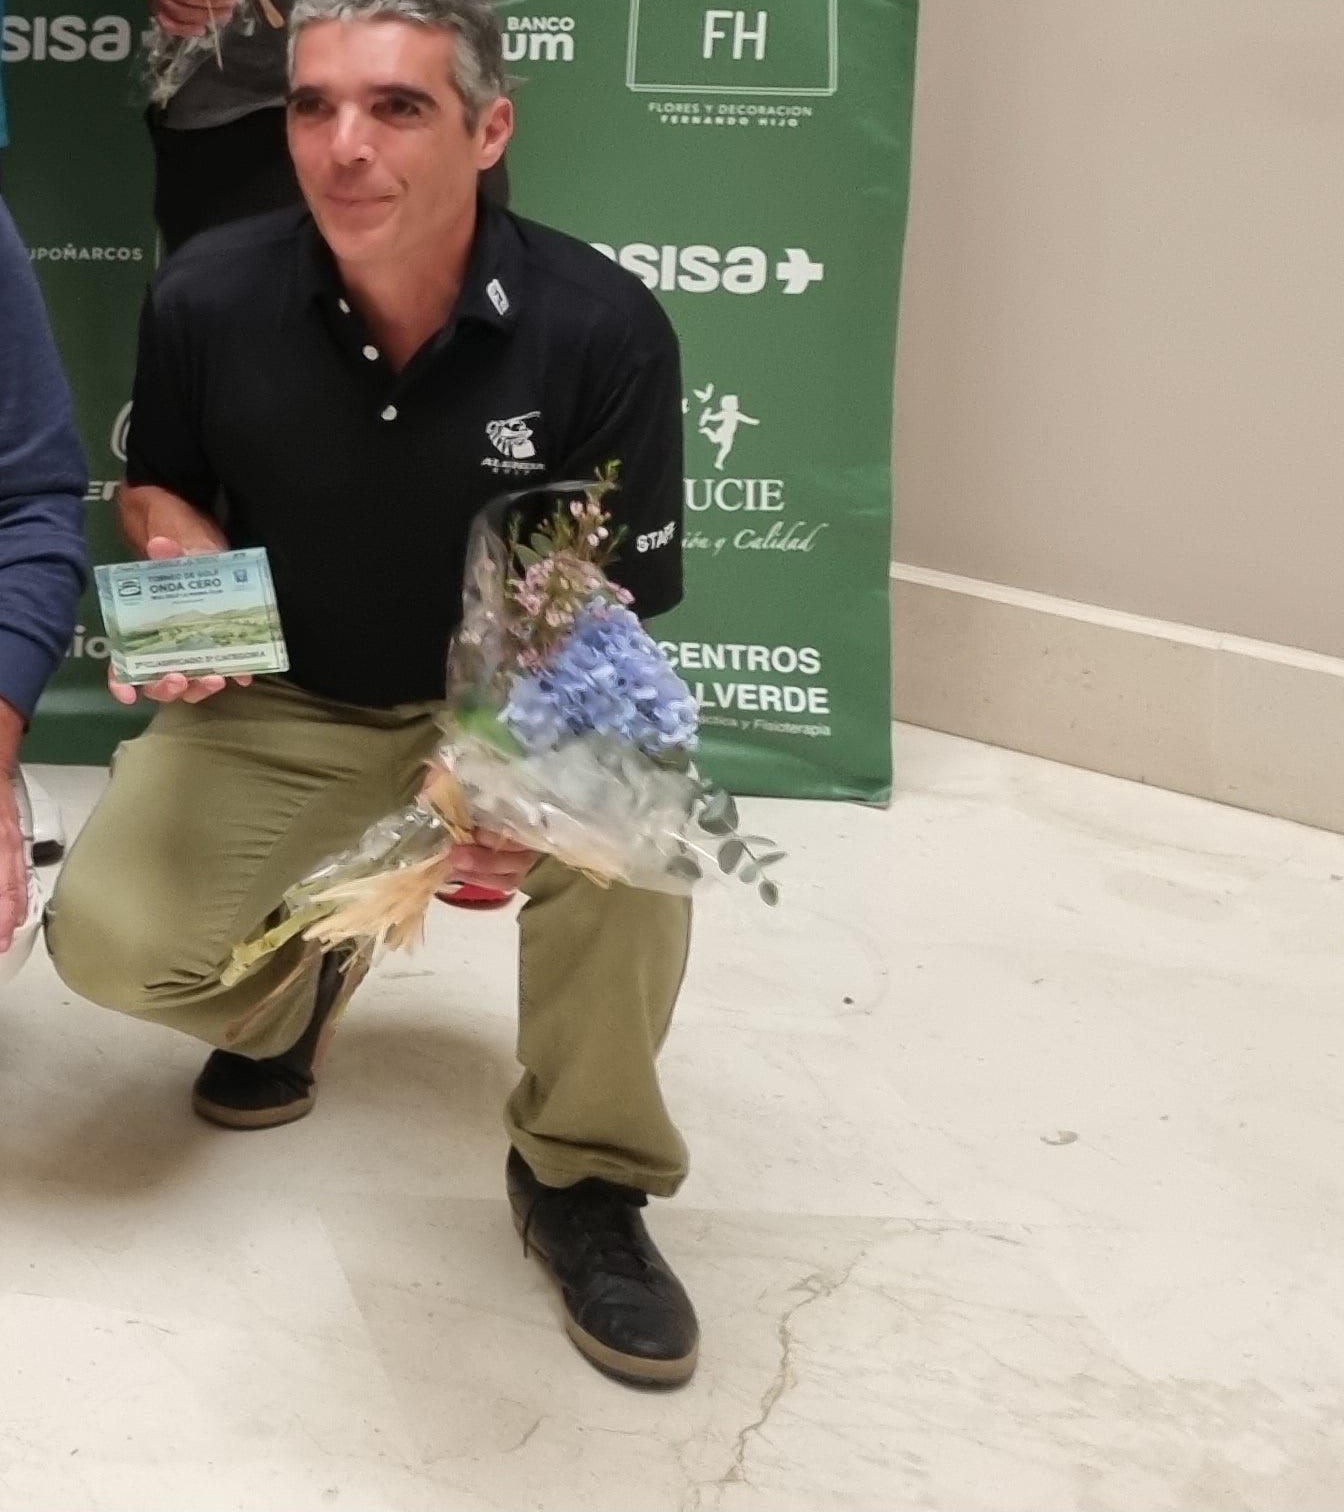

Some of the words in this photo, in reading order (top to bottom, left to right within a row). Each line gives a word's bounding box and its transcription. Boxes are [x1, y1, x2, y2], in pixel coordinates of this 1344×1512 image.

[0, 14, 132, 62] sisa
[506, 16, 576, 31] BANCO
[703, 10, 767, 60] FH
[648, 102, 700, 114] FLORES
[705, 104, 714, 114] Y
[718, 104, 813, 117] DECORACION
[660, 115, 750, 126] FERNANDO
[758, 118, 799, 128] HIJO
[590, 243, 767, 294] sisa
[683, 477, 786, 512] UCIE
[732, 520, 830, 552] Calidad
[148, 582, 186, 594] ONDA
[187, 577, 223, 590] CERO
[656, 640, 822, 676] CENTROS
[696, 682, 831, 715] LVERDE
